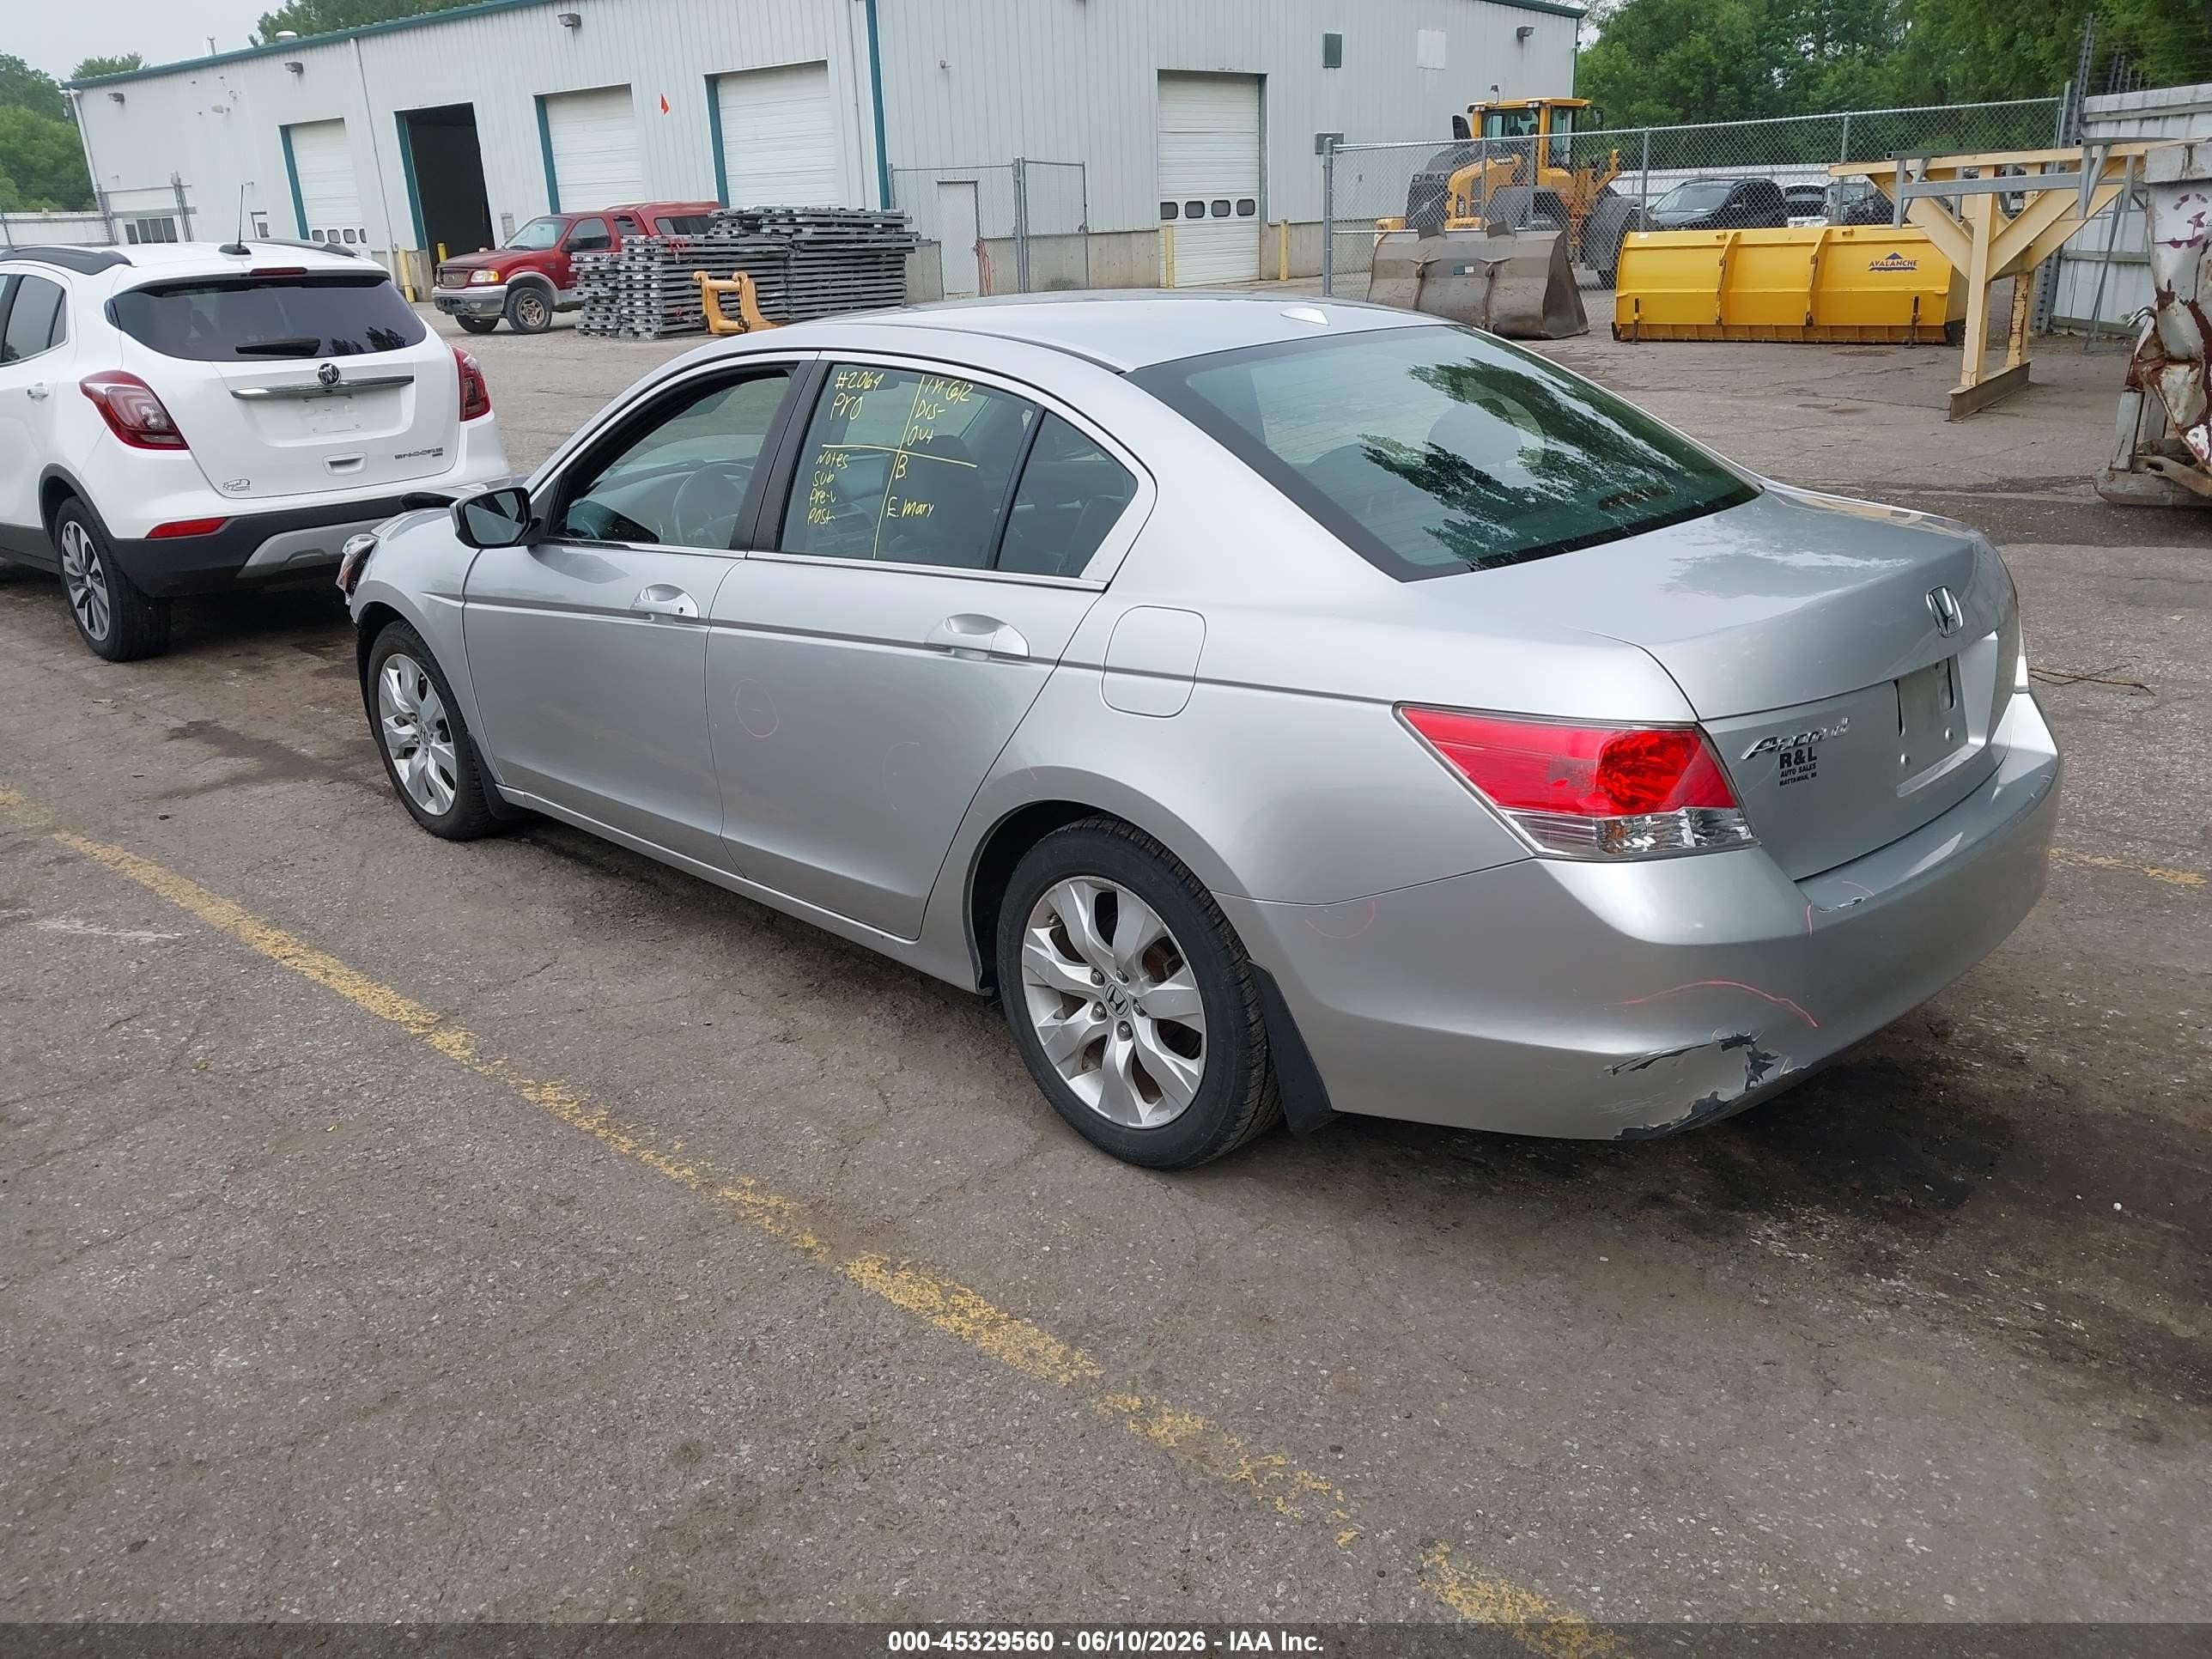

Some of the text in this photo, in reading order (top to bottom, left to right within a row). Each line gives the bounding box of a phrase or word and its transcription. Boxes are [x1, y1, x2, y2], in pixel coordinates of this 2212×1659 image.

[816, 451, 850, 470] Notes
[1741, 717, 1849, 761] Accord
[1779, 746, 1818, 770] R&L
[1780, 763, 1816, 778] AUTO SALES
